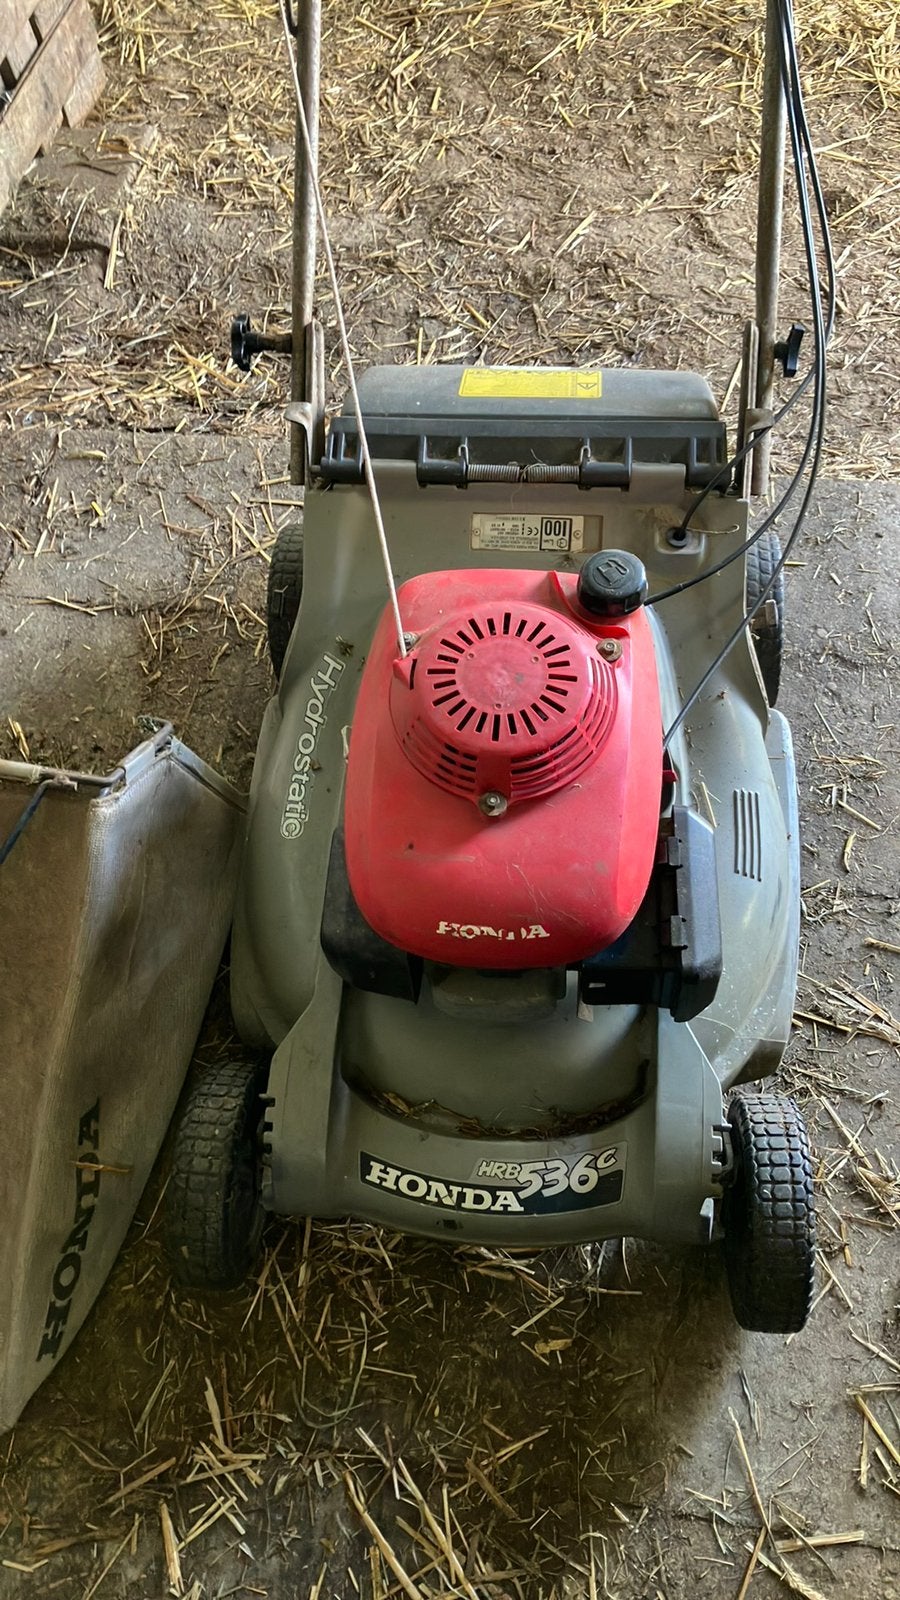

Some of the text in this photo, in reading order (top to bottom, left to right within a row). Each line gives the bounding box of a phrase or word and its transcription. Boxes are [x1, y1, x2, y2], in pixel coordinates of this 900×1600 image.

[527, 526, 539, 536] CE
[544, 520, 567, 537] 100
[281, 654, 344, 838] Hydrostatic
[365, 1160, 524, 1213] HONDA
[36, 1098, 100, 1362] HONDA
